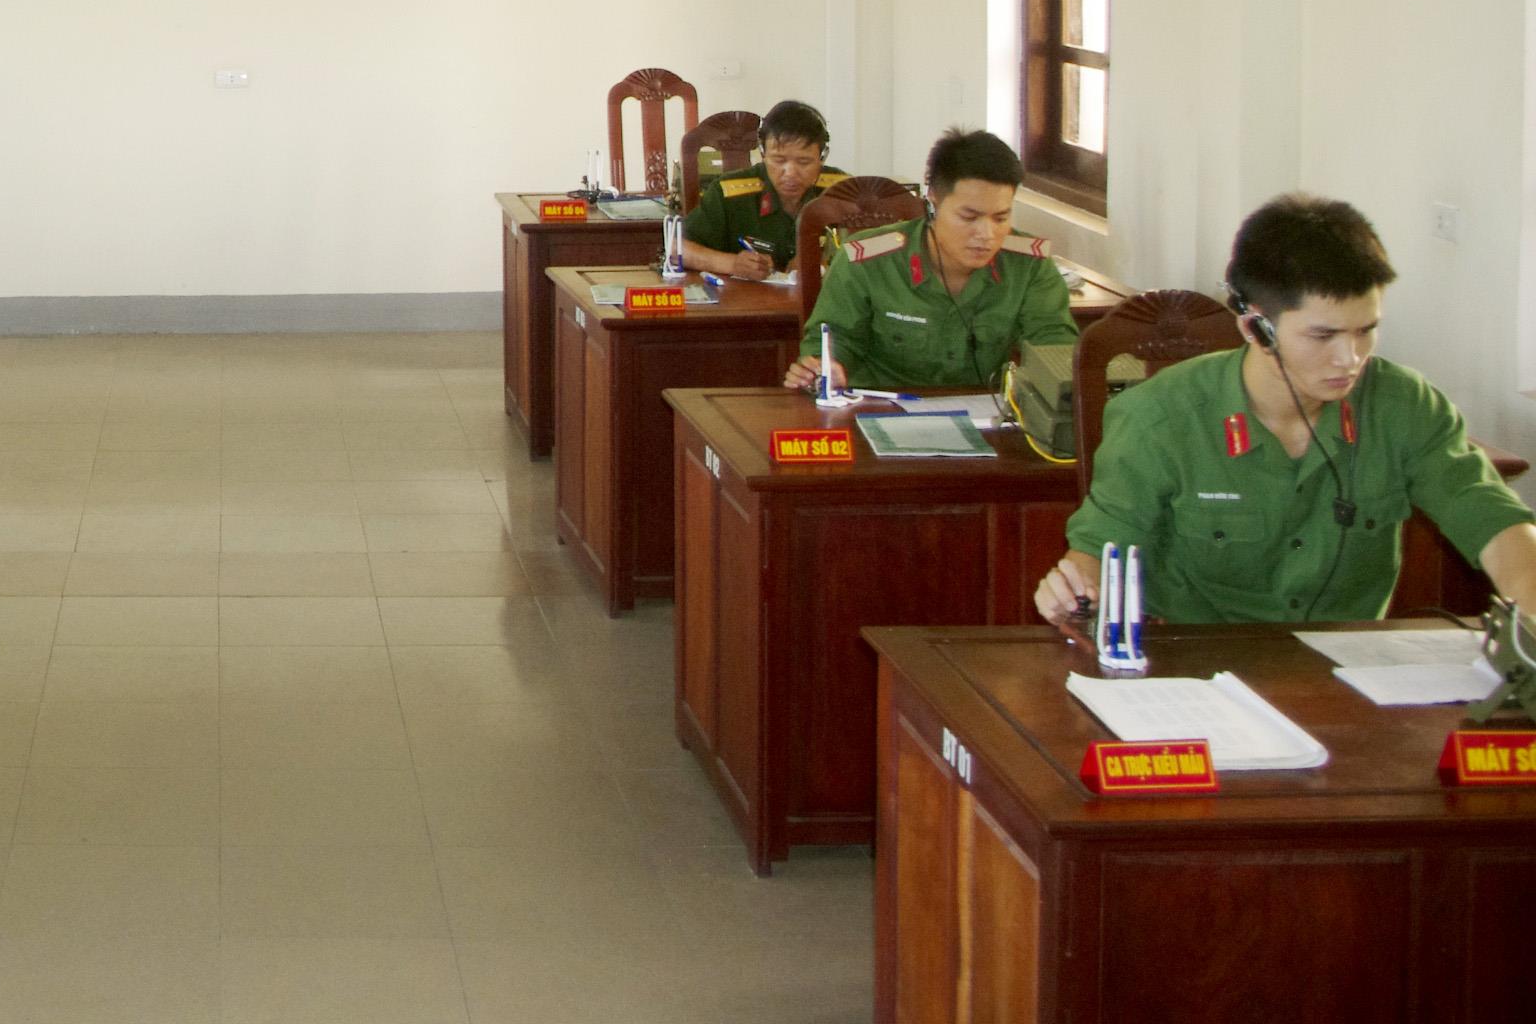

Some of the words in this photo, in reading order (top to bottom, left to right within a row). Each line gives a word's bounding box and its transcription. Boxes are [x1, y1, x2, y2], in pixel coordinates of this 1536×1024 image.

[545, 205, 561, 215] MÁY
[563, 204, 574, 215] SỐ
[632, 293, 653, 306] MÁY
[655, 291, 668, 306] SỐ
[670, 294, 682, 306] 03
[780, 438, 808, 456] MÁY
[811, 436, 830, 455] SỐ
[831, 441, 848, 455] 02
[943, 726, 958, 768] BT
[958, 744, 971, 785] 01
[1105, 756, 1124, 777] CA
[1122, 753, 1153, 781] TRỰC
[1151, 746, 1179, 776] KIỂU
[1466, 743, 1510, 772] MÁY
